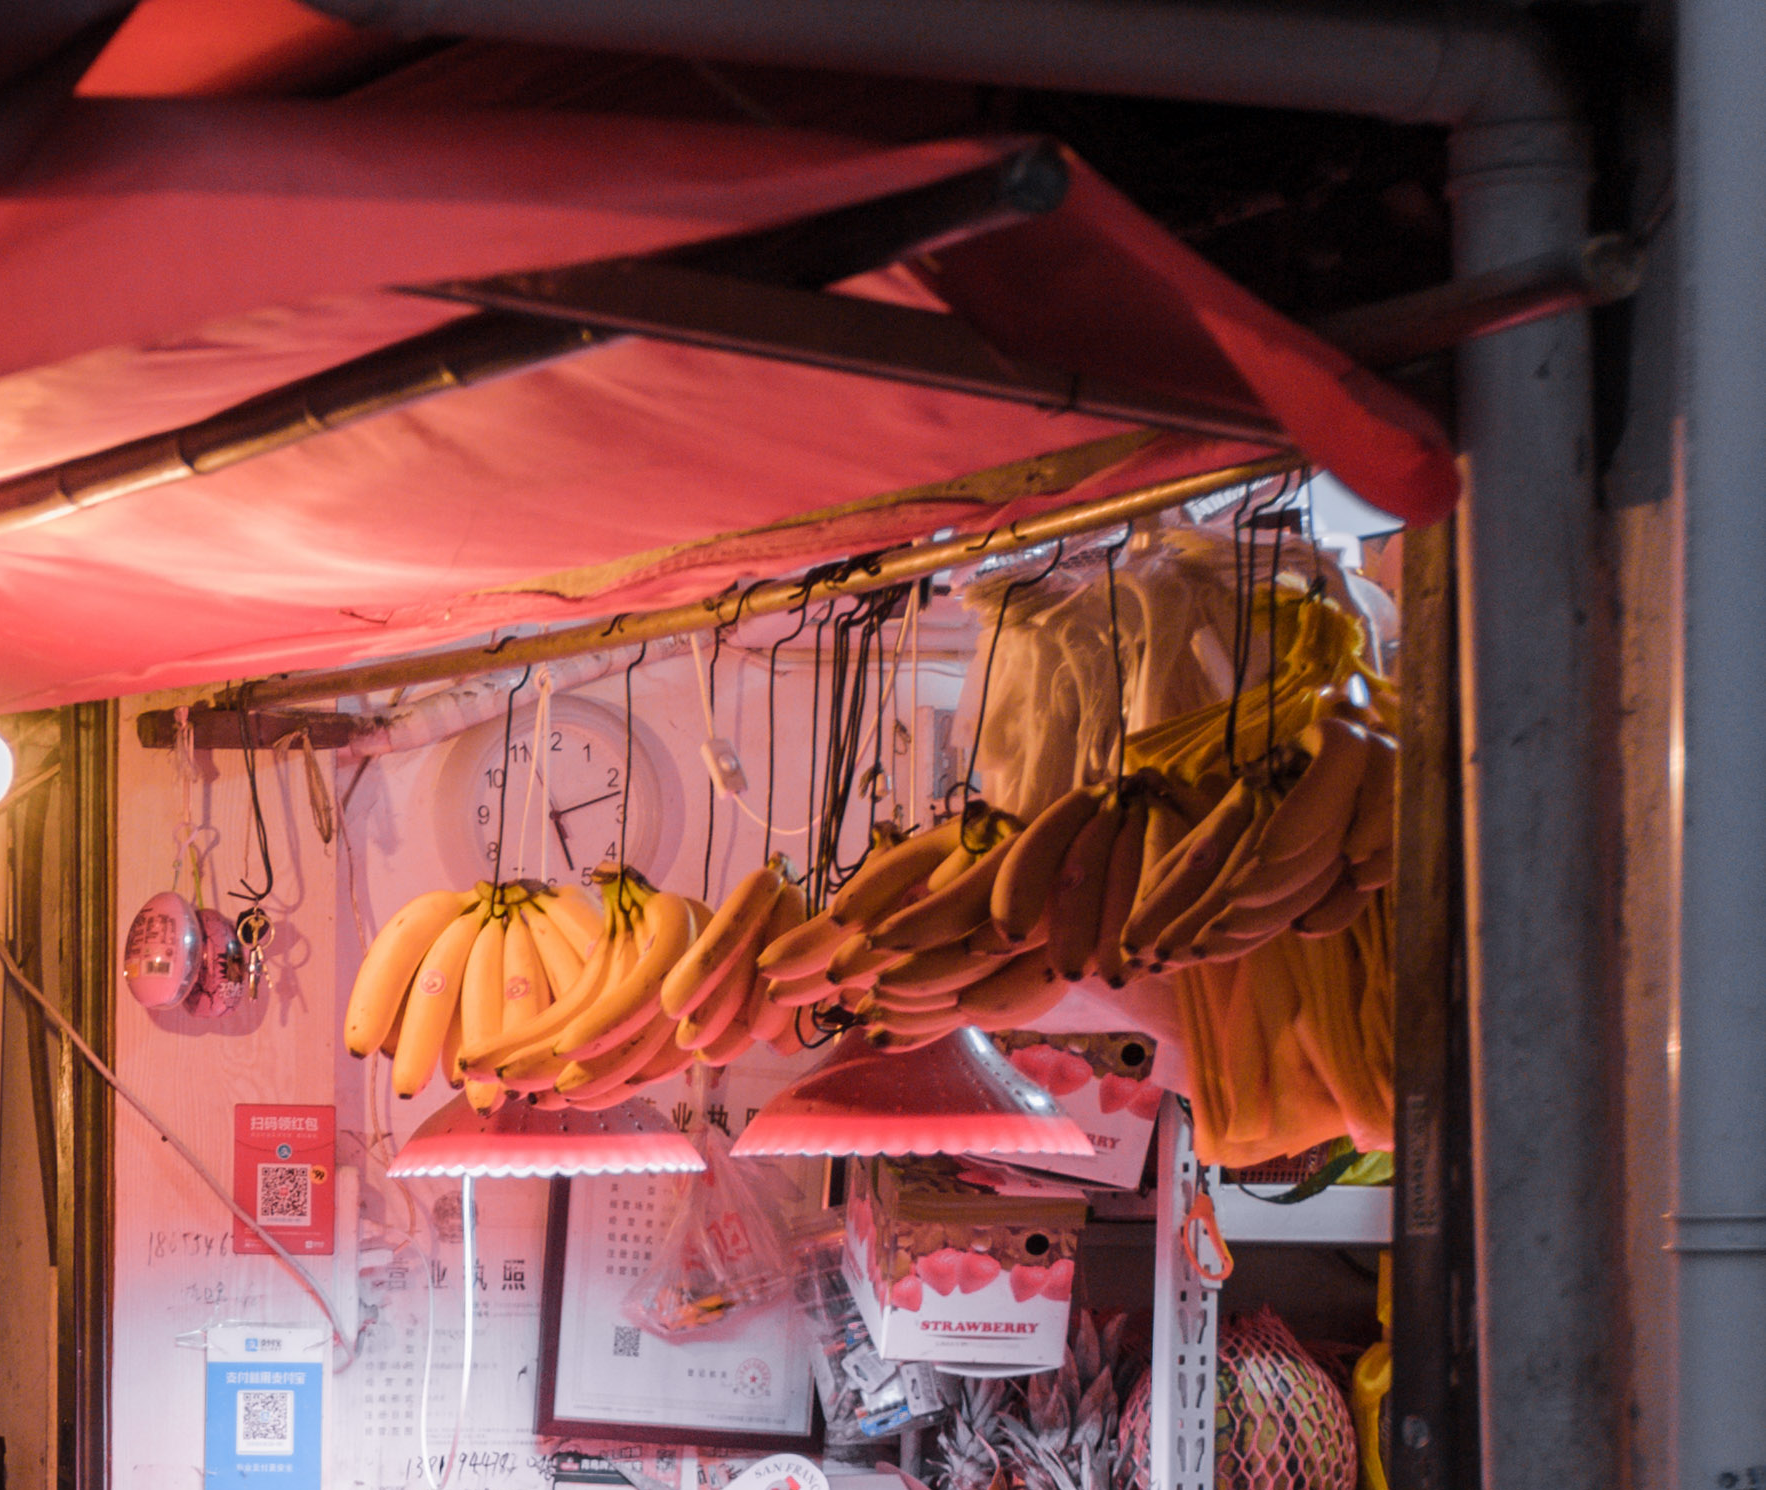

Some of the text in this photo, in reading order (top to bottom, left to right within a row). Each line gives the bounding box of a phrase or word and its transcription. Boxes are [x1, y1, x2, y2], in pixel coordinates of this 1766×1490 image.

[583, 744, 592, 763] 1
[607, 768, 620, 788] 2
[477, 805, 490, 825] 9
[604, 841, 617, 860] 4
[250, 1116, 319, 1132] 扫码领红包
[920, 1320, 1040, 1335] STRAWBERRY
[754, 1462, 784, 1479] SAN
